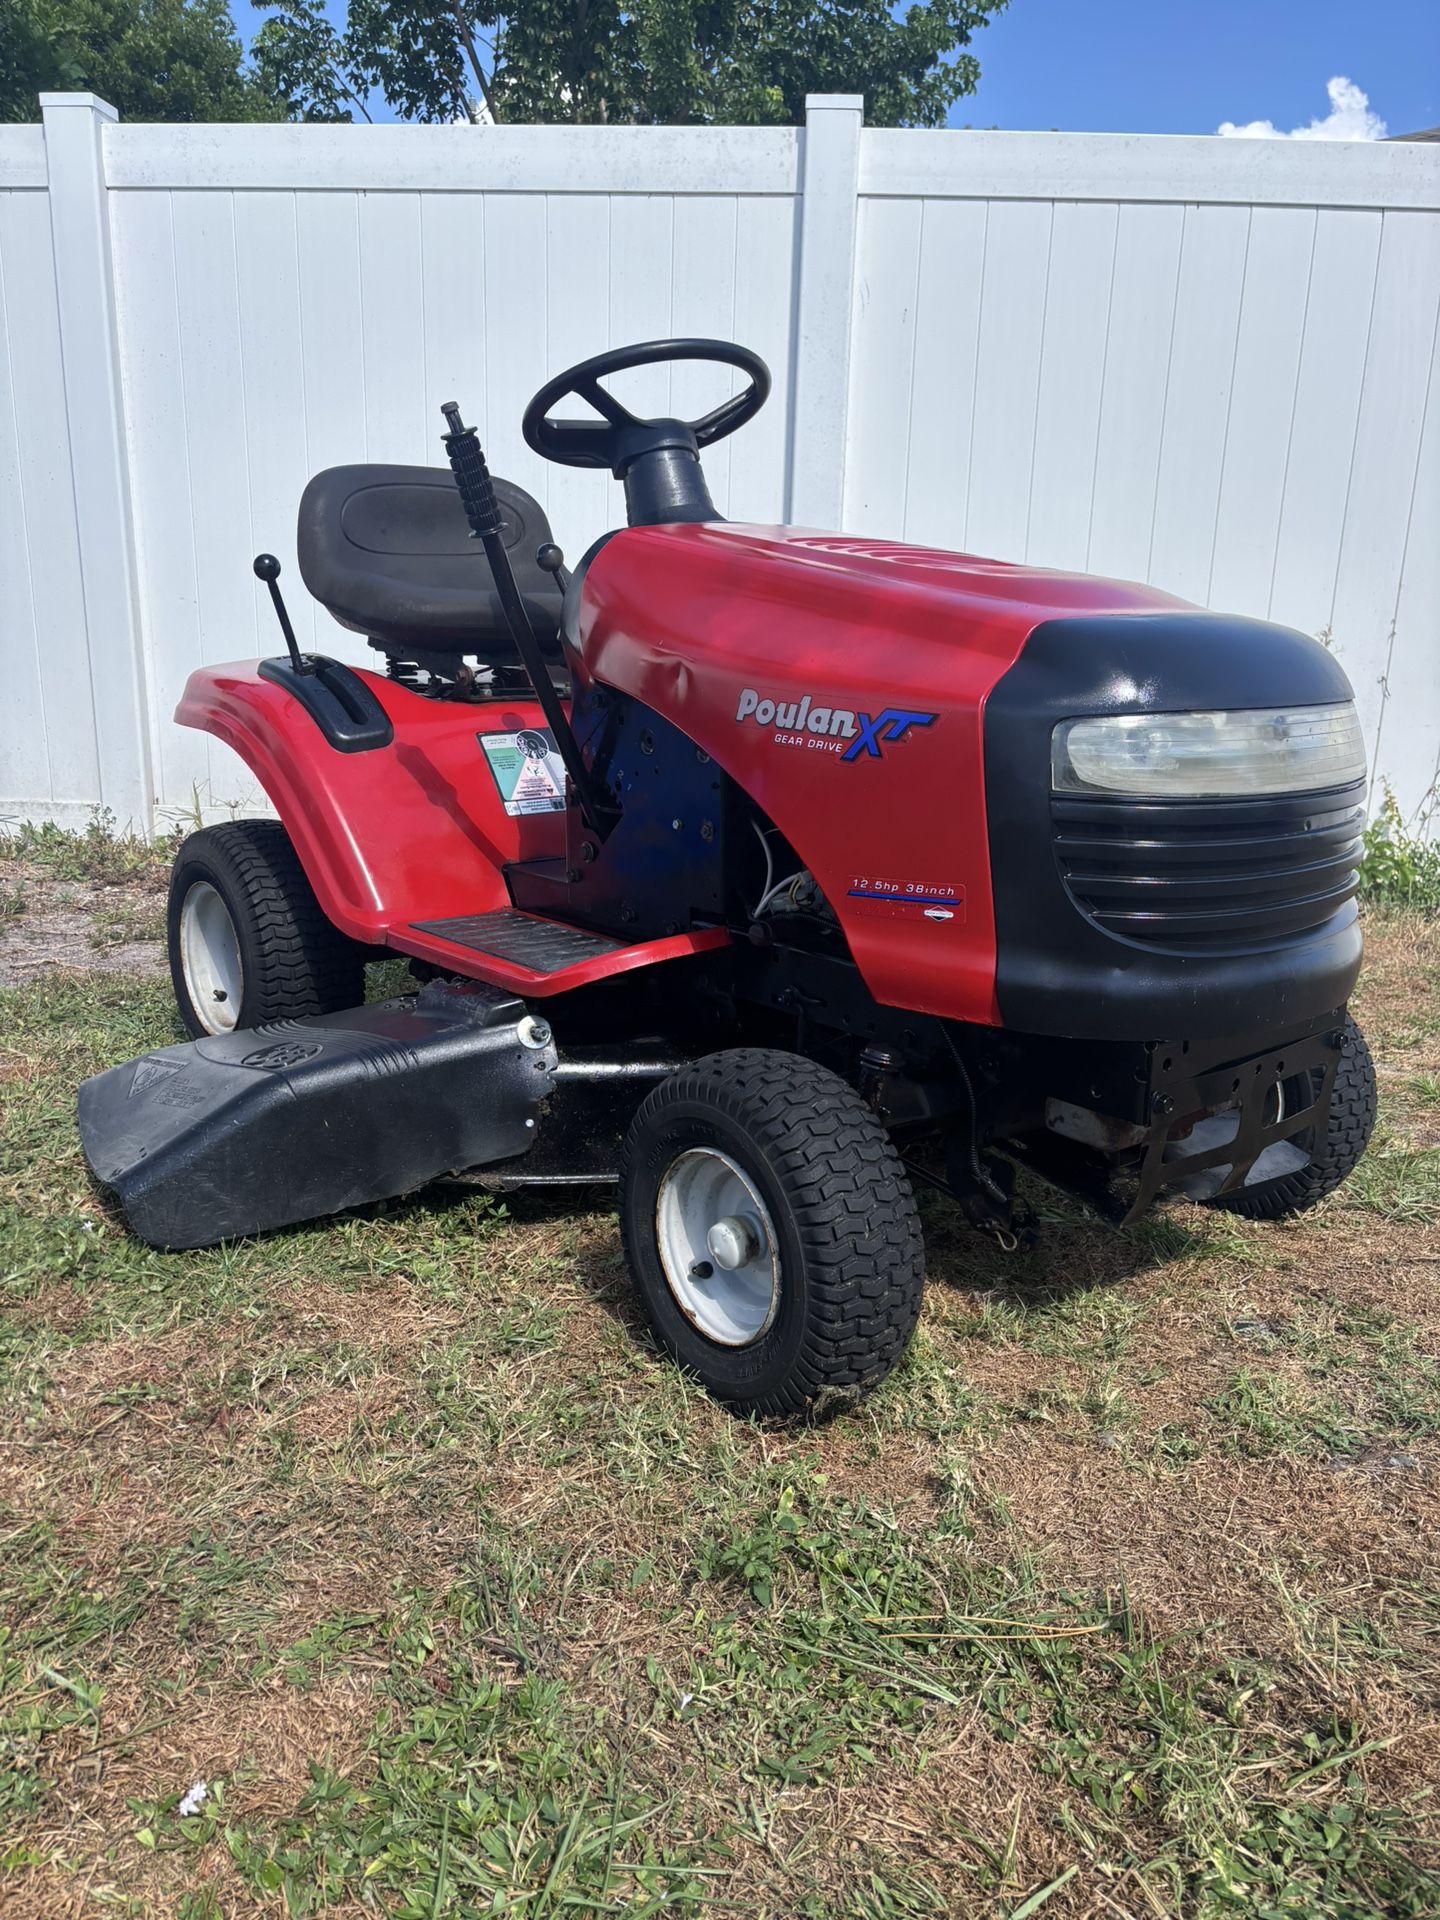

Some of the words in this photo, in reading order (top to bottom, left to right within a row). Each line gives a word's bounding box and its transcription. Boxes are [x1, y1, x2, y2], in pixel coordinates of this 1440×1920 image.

[736, 687, 858, 738] Poulan
[840, 707, 940, 762] XT
[774, 733, 803, 747] GEAR
[807, 739, 843, 753] DRIVE
[853, 878, 899, 892] 12.5hp
[906, 883, 955, 896] 38inch
